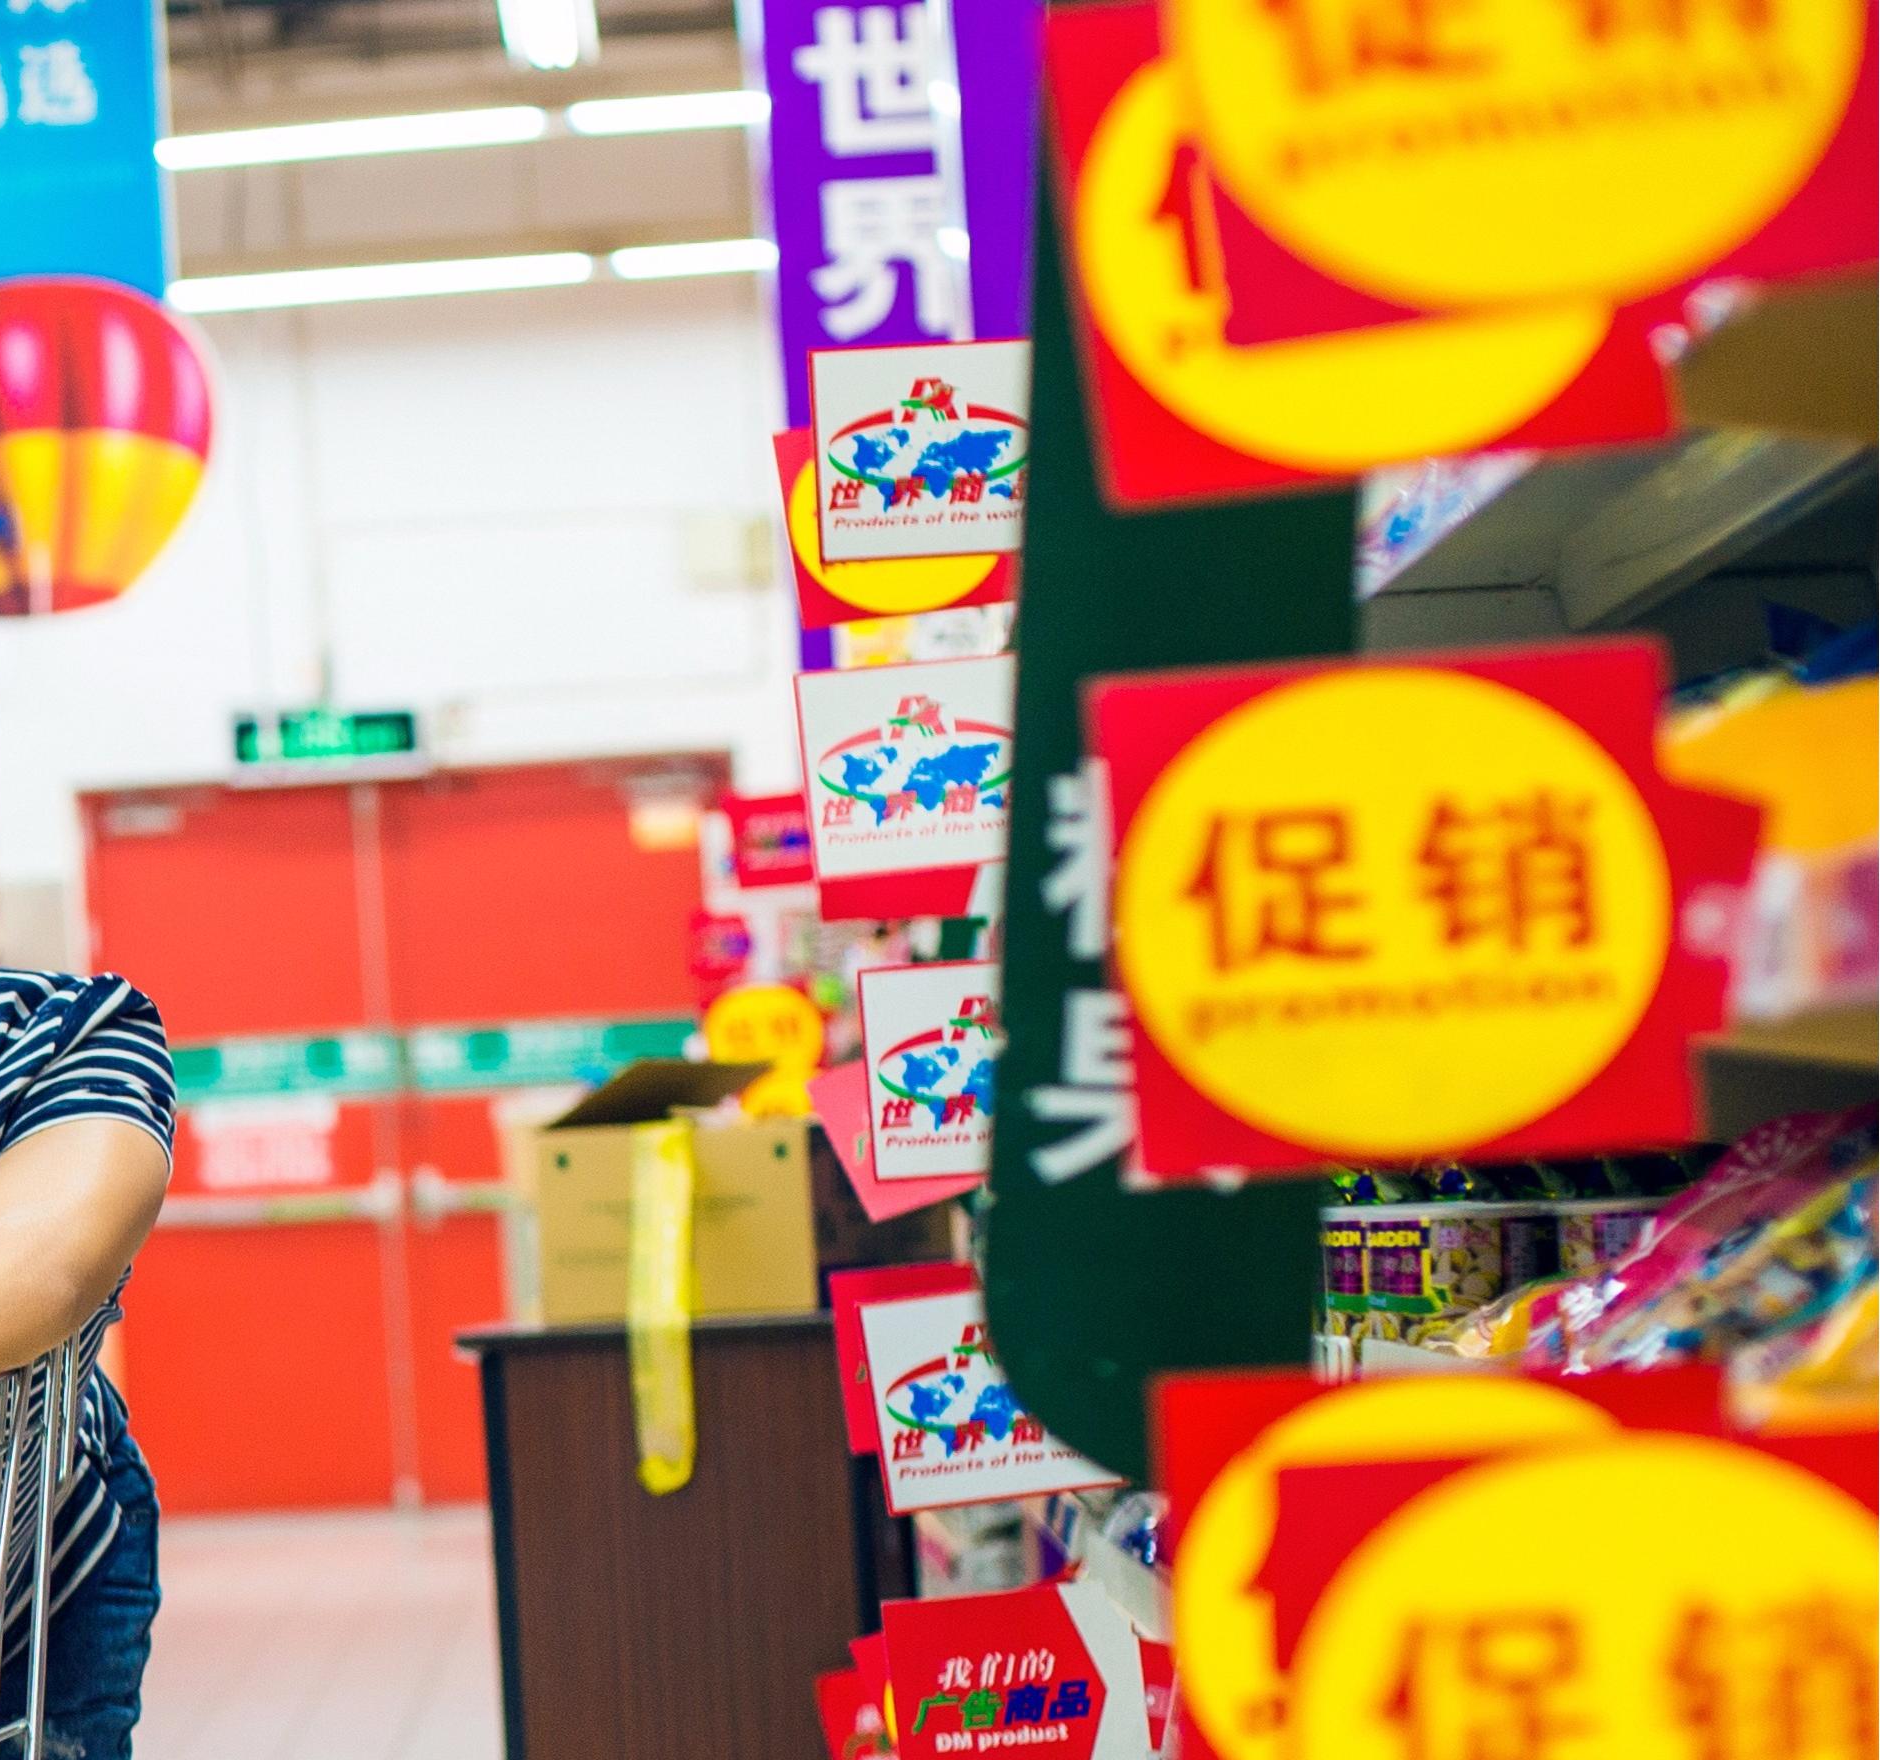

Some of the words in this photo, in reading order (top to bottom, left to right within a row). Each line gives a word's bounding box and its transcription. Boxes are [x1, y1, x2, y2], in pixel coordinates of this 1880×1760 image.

[792, 3, 947, 342] 世界
[829, 472, 1026, 512] 世界商
[833, 513, 920, 530] Products
[925, 512, 944, 526] of
[948, 511, 980, 526] the
[827, 825, 913, 848] Products
[919, 824, 944, 840] of
[948, 820, 976, 836] the
[1183, 786, 1609, 978] 促销
[885, 1129, 973, 1150] Products
[899, 1461, 984, 1481] Products
[990, 1453, 1009, 1469] of
[1015, 1450, 1046, 1466] the
[938, 1648, 1056, 1691] 我们的
[912, 1680, 1092, 1735] 广告商品
[936, 1732, 974, 1753] DM
[978, 1724, 1069, 1752] product
